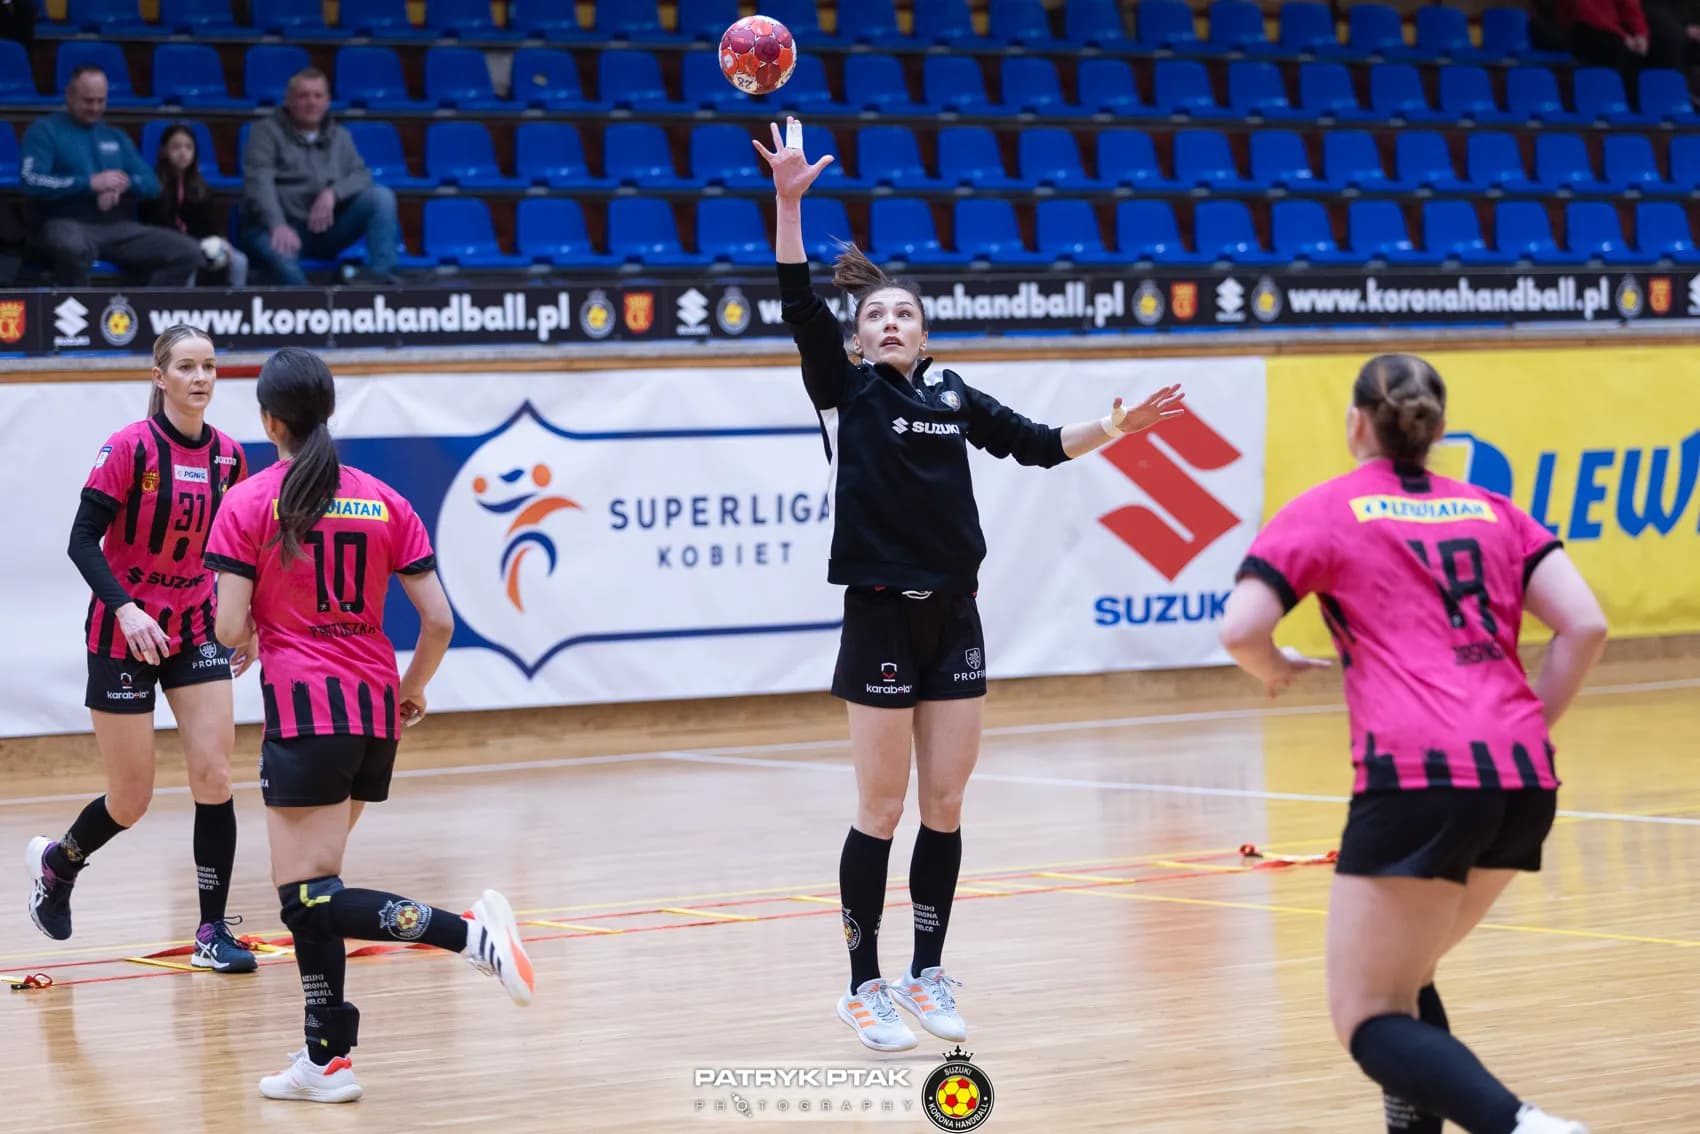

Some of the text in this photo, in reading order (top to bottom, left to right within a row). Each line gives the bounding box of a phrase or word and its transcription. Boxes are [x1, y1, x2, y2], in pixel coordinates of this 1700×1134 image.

[149, 292, 570, 342] www.koronahandball.pl
[1288, 275, 1609, 320] www.koronahandball.pl
[911, 421, 960, 435] SUZUKI
[174, 491, 206, 533] 31
[609, 493, 830, 531] SUPERLIGA
[304, 530, 368, 614] 10
[657, 541, 792, 569] KOBIET
[1094, 591, 1233, 626] SUZUK
